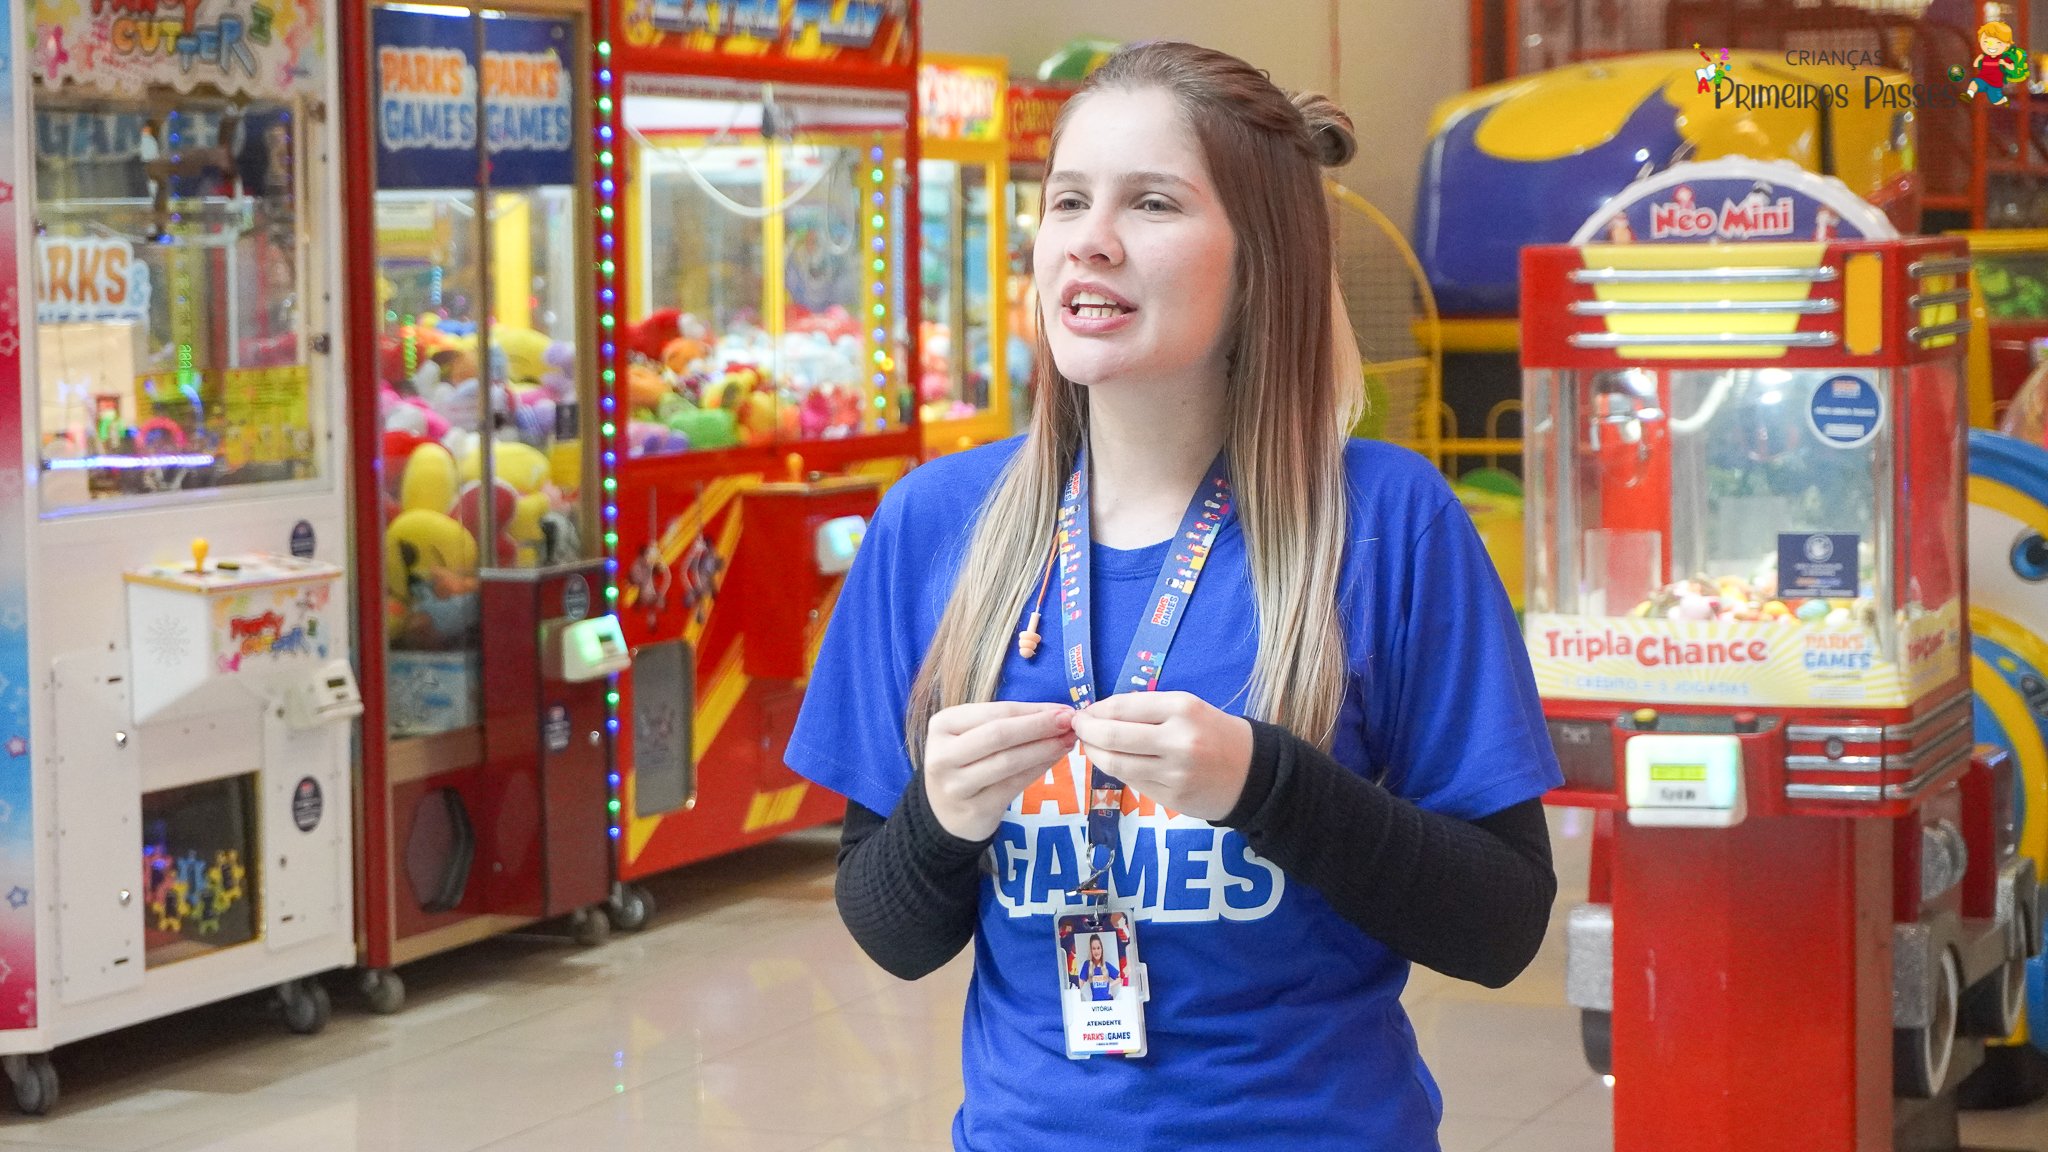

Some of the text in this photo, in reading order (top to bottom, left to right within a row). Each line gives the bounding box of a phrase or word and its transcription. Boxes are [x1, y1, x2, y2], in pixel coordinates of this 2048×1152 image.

[381, 52, 462, 97] PARKS
[482, 59, 558, 99] PARKS
[385, 100, 475, 141] GAMES
[487, 104, 568, 142] GAMES
[1656, 202, 1790, 233] Neo Mini
[38, 245, 128, 304] RKS
[1151, 596, 1169, 624] PARKS
[1160, 596, 1178, 627] GAMES
[1545, 629, 1768, 668] Tripla Chance
[1804, 651, 1871, 670] GAMES
[993, 820, 1274, 910] GAMES
[1082, 1031, 1131, 1041] PARKS GAMES
